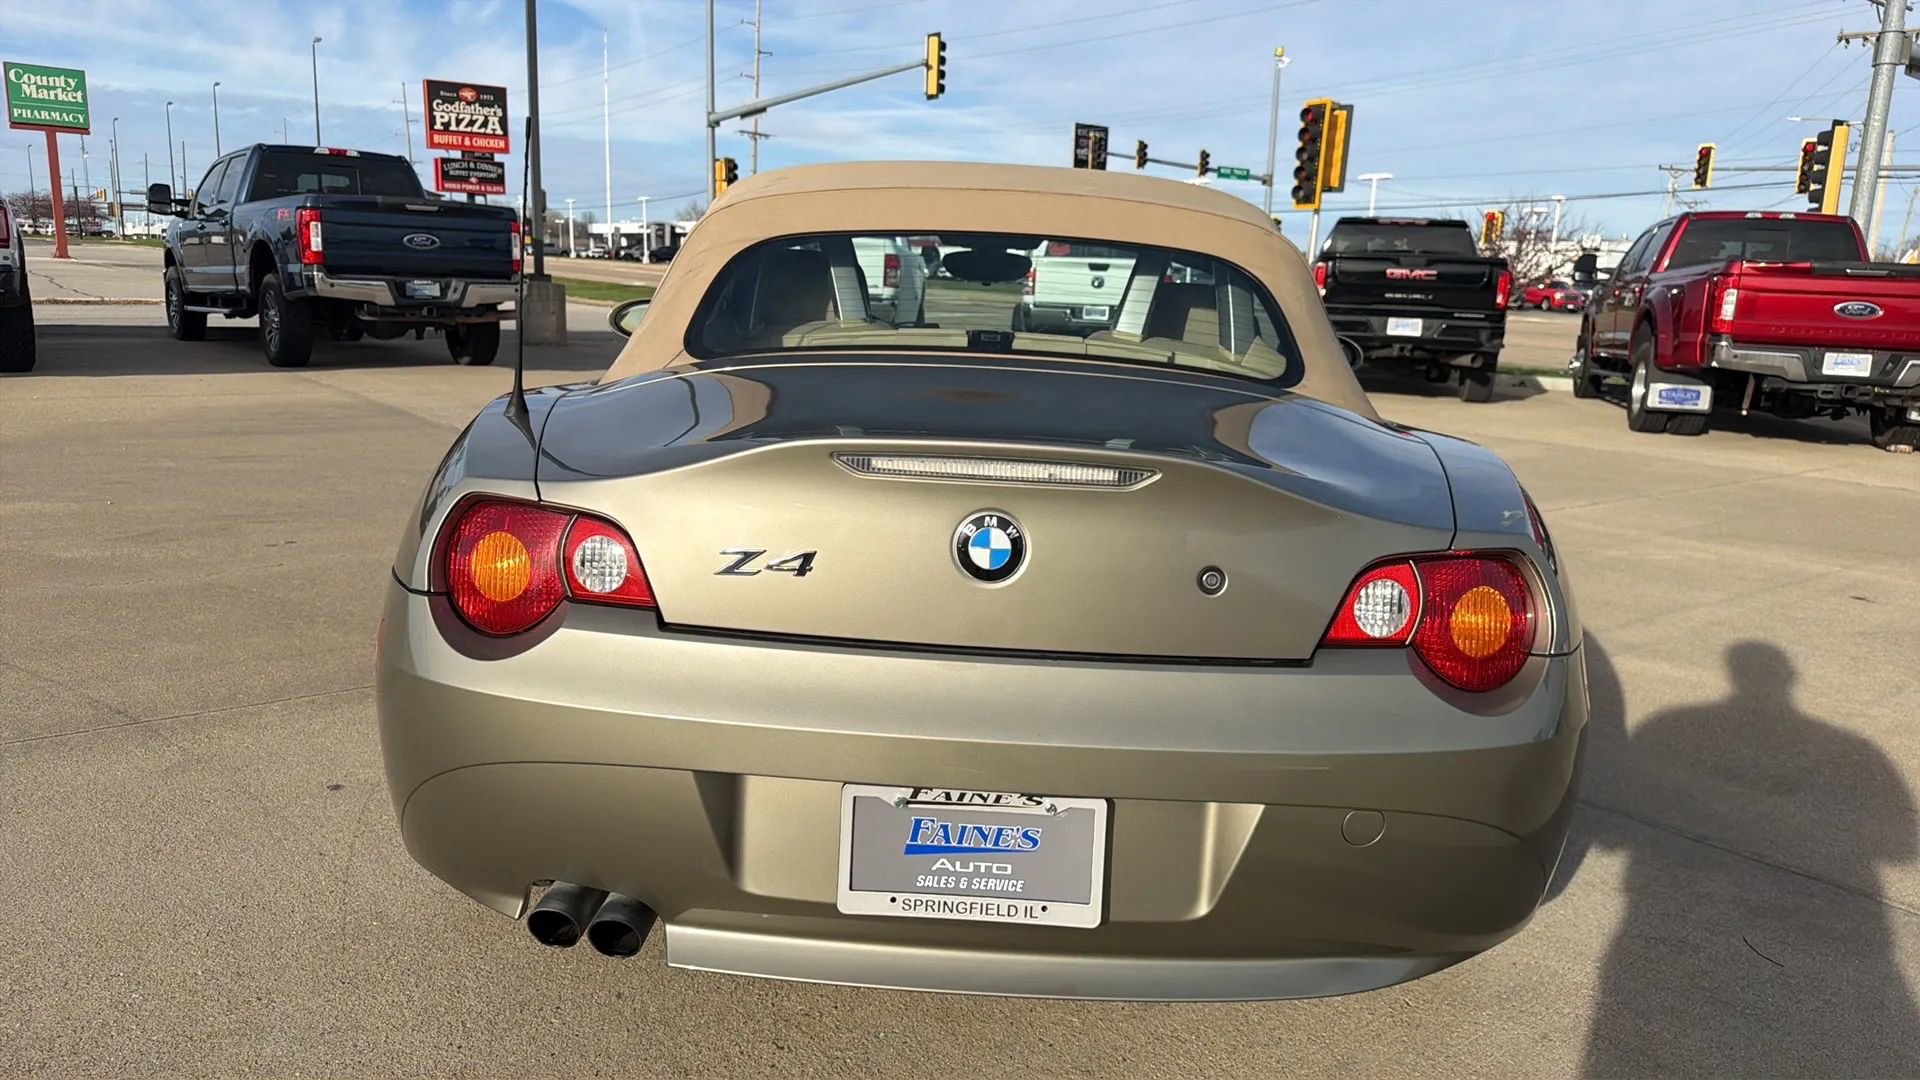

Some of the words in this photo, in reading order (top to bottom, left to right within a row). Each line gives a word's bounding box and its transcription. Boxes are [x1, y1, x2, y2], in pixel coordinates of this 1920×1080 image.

[9, 68, 78, 91] County
[21, 84, 83, 103] Market
[13, 108, 85, 123] PHARMACY
[433, 99, 503, 117] Godfather's
[433, 112, 504, 135] PIZZA
[433, 134, 462, 145] BUFFET
[464, 136, 471, 146] &
[472, 137, 505, 148] CHICKEN
[443, 161, 468, 171] LUNCH
[469, 161, 475, 169] &
[476, 162, 503, 175] DINNER
[487, 185, 504, 193] SLOTS
[1386, 268, 1438, 280] GMC
[1661, 389, 1698, 401] STANLEY
[963, 516, 1020, 540] BMW
[713, 549, 818, 577] Z4
[908, 787, 1044, 807] FAINE'S
[906, 816, 1042, 851] FAINE'S
[931, 858, 1012, 875] AUTO
[916, 874, 956, 889] SALES
[959, 877, 968, 889] &
[971, 878, 1025, 893] SERVICE
[901, 897, 1019, 918] SPRINGFIELD
[1024, 905, 1039, 919] IL
